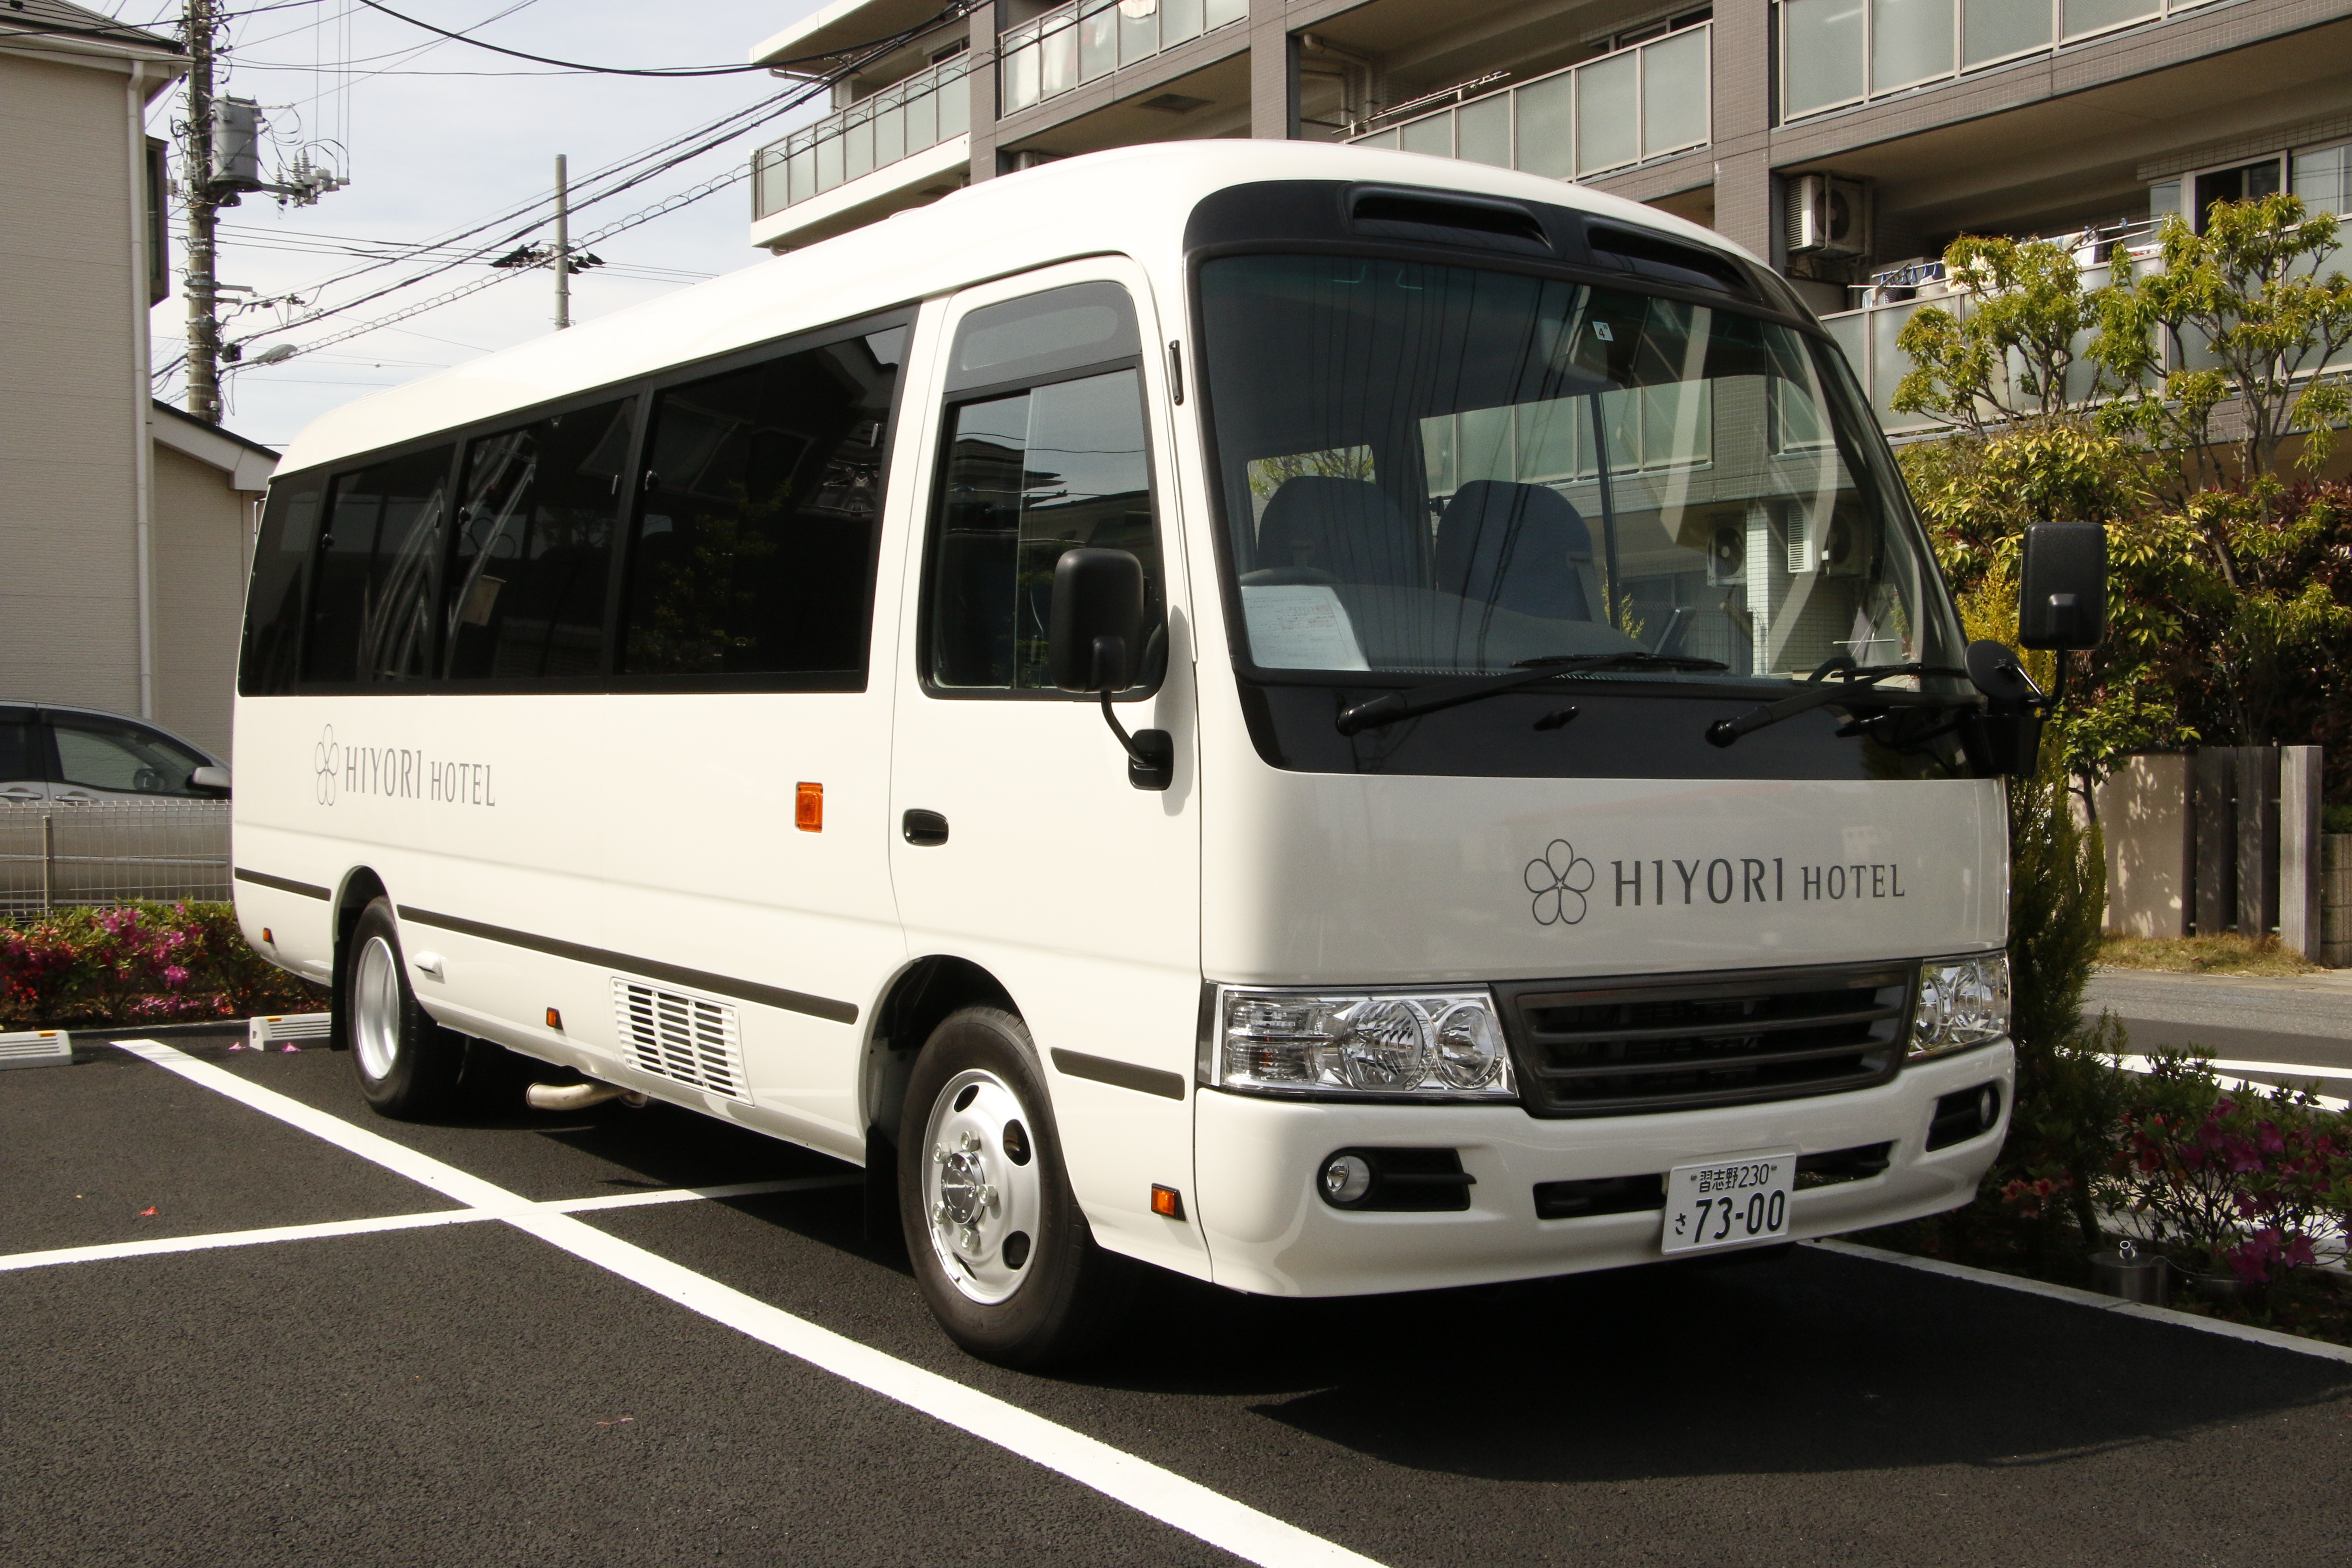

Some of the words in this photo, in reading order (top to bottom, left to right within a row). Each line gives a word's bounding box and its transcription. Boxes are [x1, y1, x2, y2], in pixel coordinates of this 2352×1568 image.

[1599, 328, 1605, 338] 4
[345, 746, 422, 799] HIYORI
[430, 761, 496, 807] HOTEL
[1611, 858, 1783, 906] HIYORI
[1801, 864, 1906, 900] HOTEL
[1675, 1213, 1686, 1235] さ
[1694, 1189, 1785, 1243] 73-00
